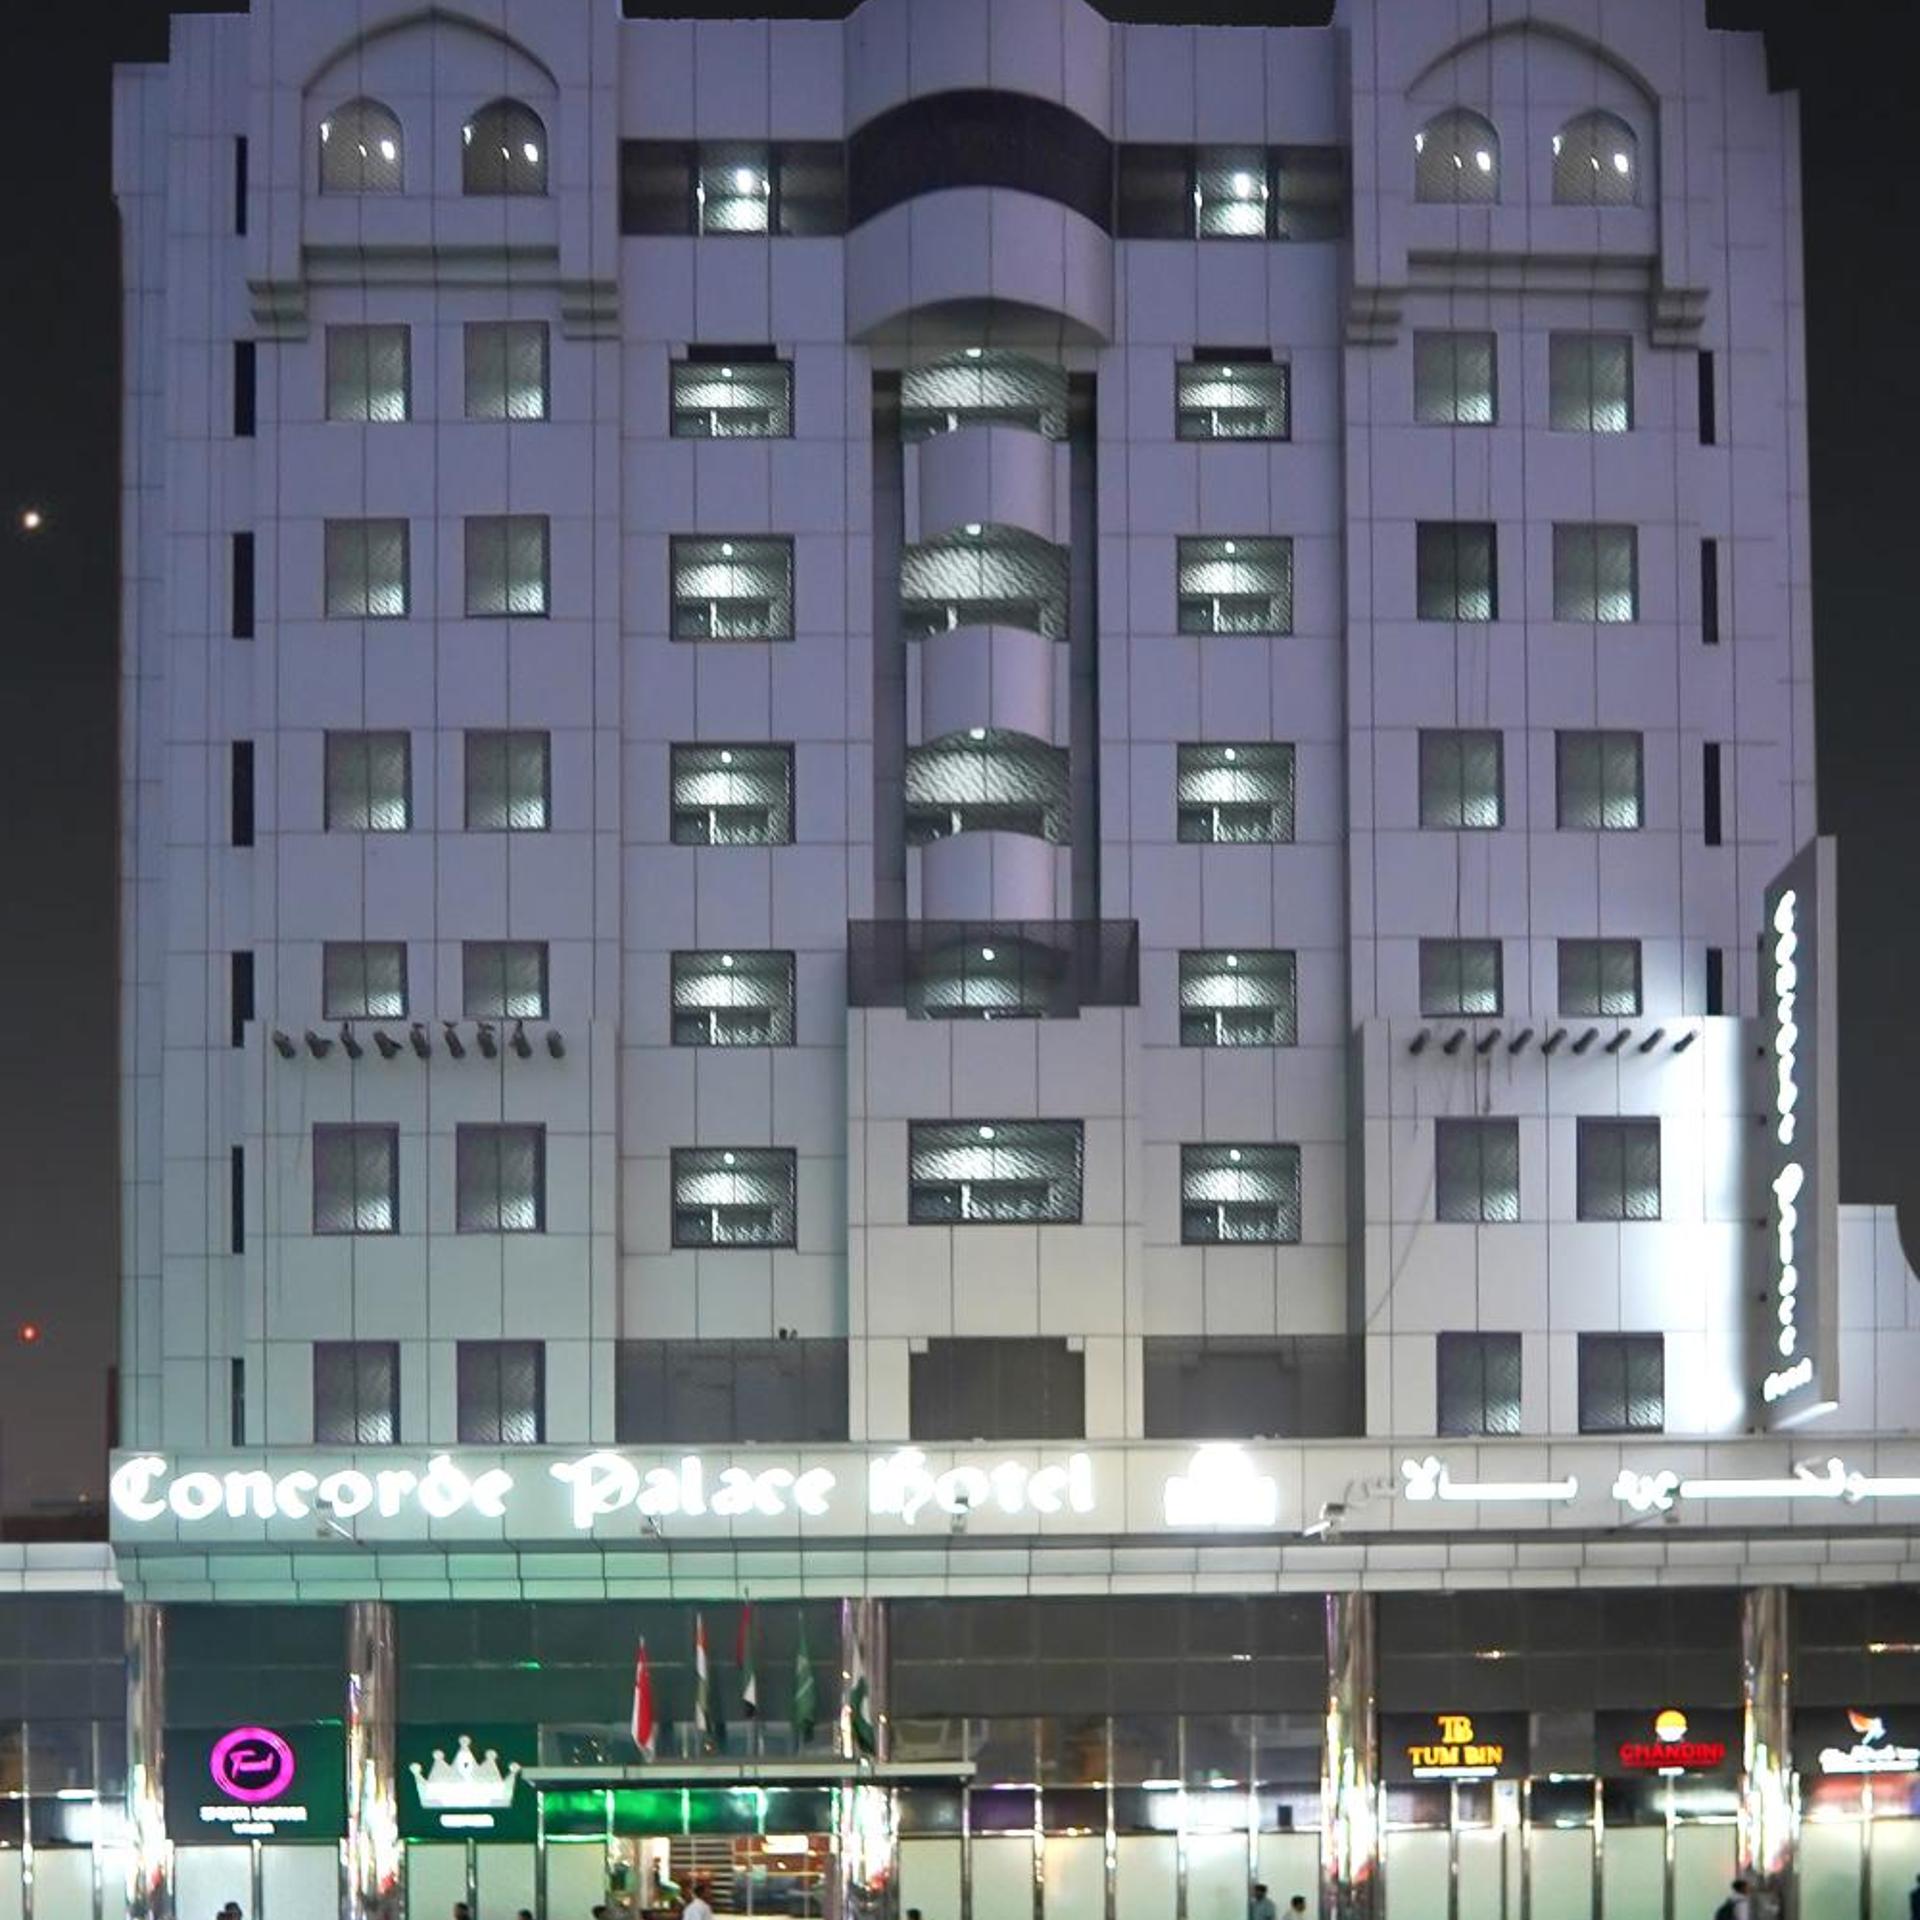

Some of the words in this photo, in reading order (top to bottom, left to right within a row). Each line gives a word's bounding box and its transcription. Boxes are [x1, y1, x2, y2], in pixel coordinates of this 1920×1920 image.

[111, 1456, 513, 1521] Concorde
[550, 1450, 836, 1529] Palace
[869, 1449, 1095, 1525] Hotel
[1408, 1746, 1460, 1766] TUM
[1463, 1745, 1504, 1766] BIN
